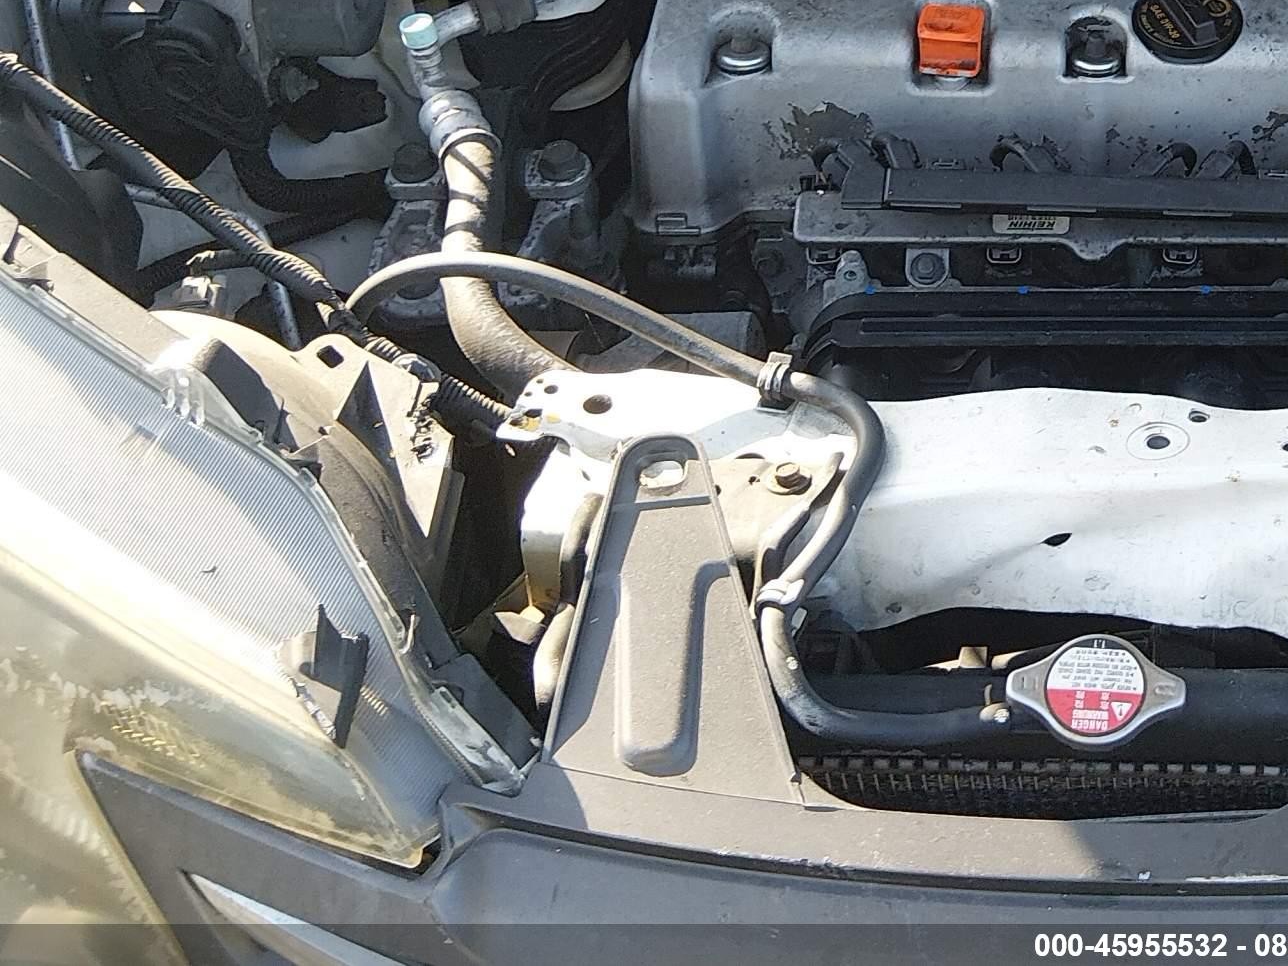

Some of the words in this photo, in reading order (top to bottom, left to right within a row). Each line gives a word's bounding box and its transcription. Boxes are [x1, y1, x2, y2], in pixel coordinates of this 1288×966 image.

[1008, 221, 1056, 229] KEIHIN
[1093, 639, 1105, 649] 1.1
[1071, 719, 1108, 731] DANGER
